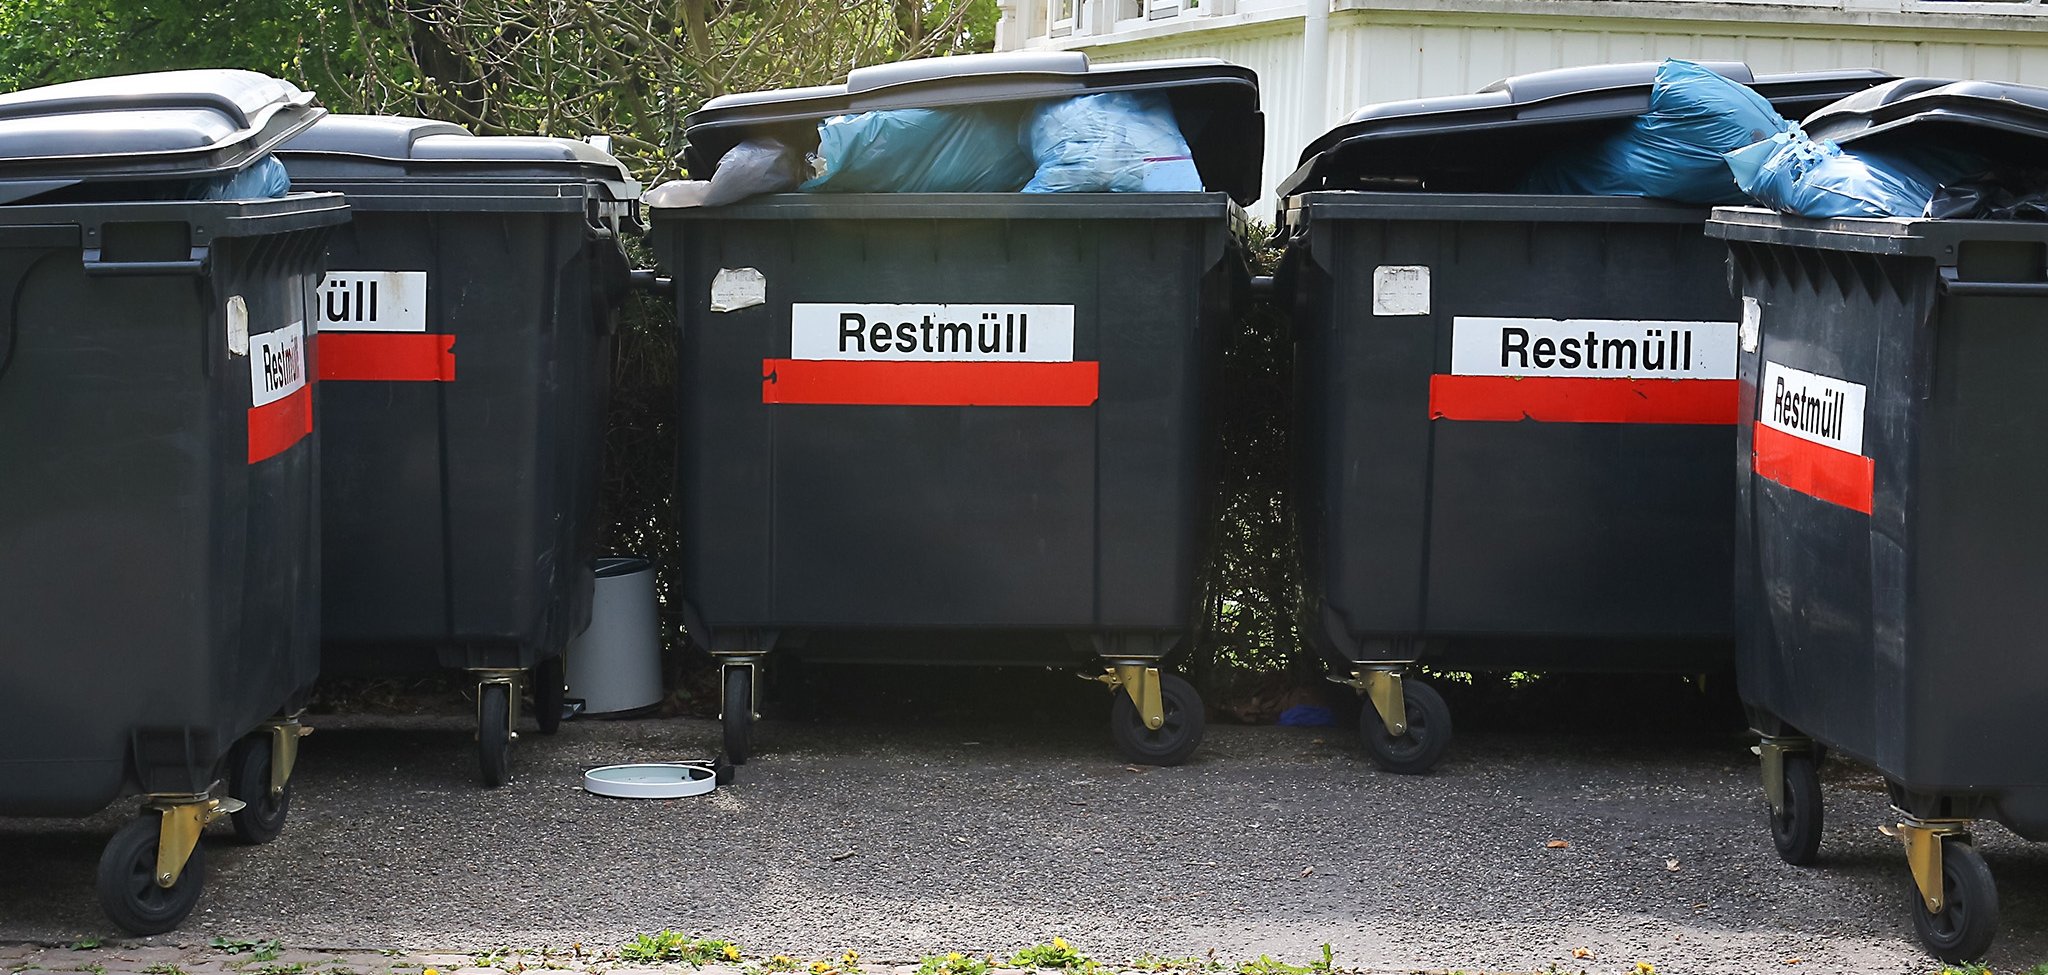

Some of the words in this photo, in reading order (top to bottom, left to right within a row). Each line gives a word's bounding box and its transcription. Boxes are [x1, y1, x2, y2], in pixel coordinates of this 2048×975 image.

[839, 312, 1027, 354] Restmüll
[1501, 327, 1692, 371] Restmüll
[1773, 376, 1845, 441] Restmüll
